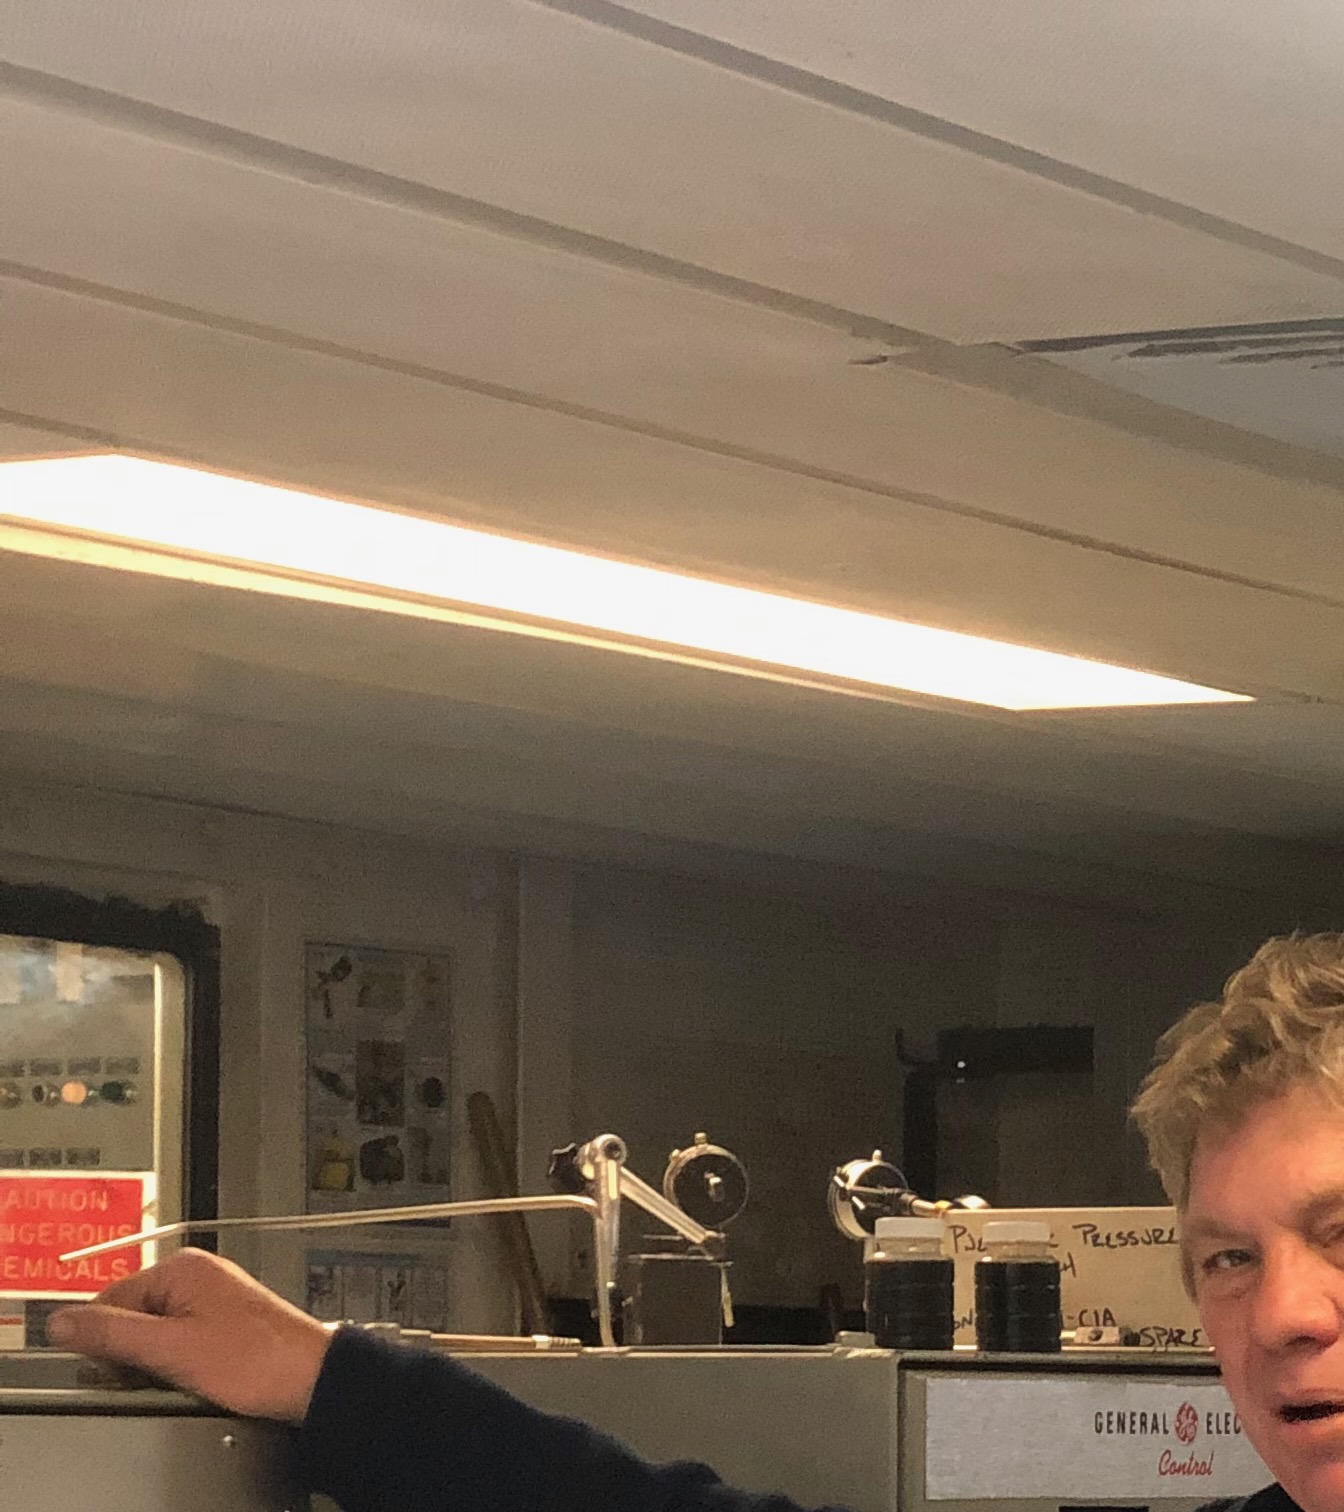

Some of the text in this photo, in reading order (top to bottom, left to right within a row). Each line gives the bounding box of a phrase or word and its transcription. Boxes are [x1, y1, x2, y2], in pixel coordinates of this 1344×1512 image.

[4, 1188, 108, 1211] AUTION
[0, 1222, 134, 1246] NGEROUS
[3, 1255, 130, 1282] EMICALS
[1094, 1410, 1170, 1435] GENERAL
[1206, 1411, 1242, 1435] ELEC
[1158, 1449, 1215, 1476] Control
